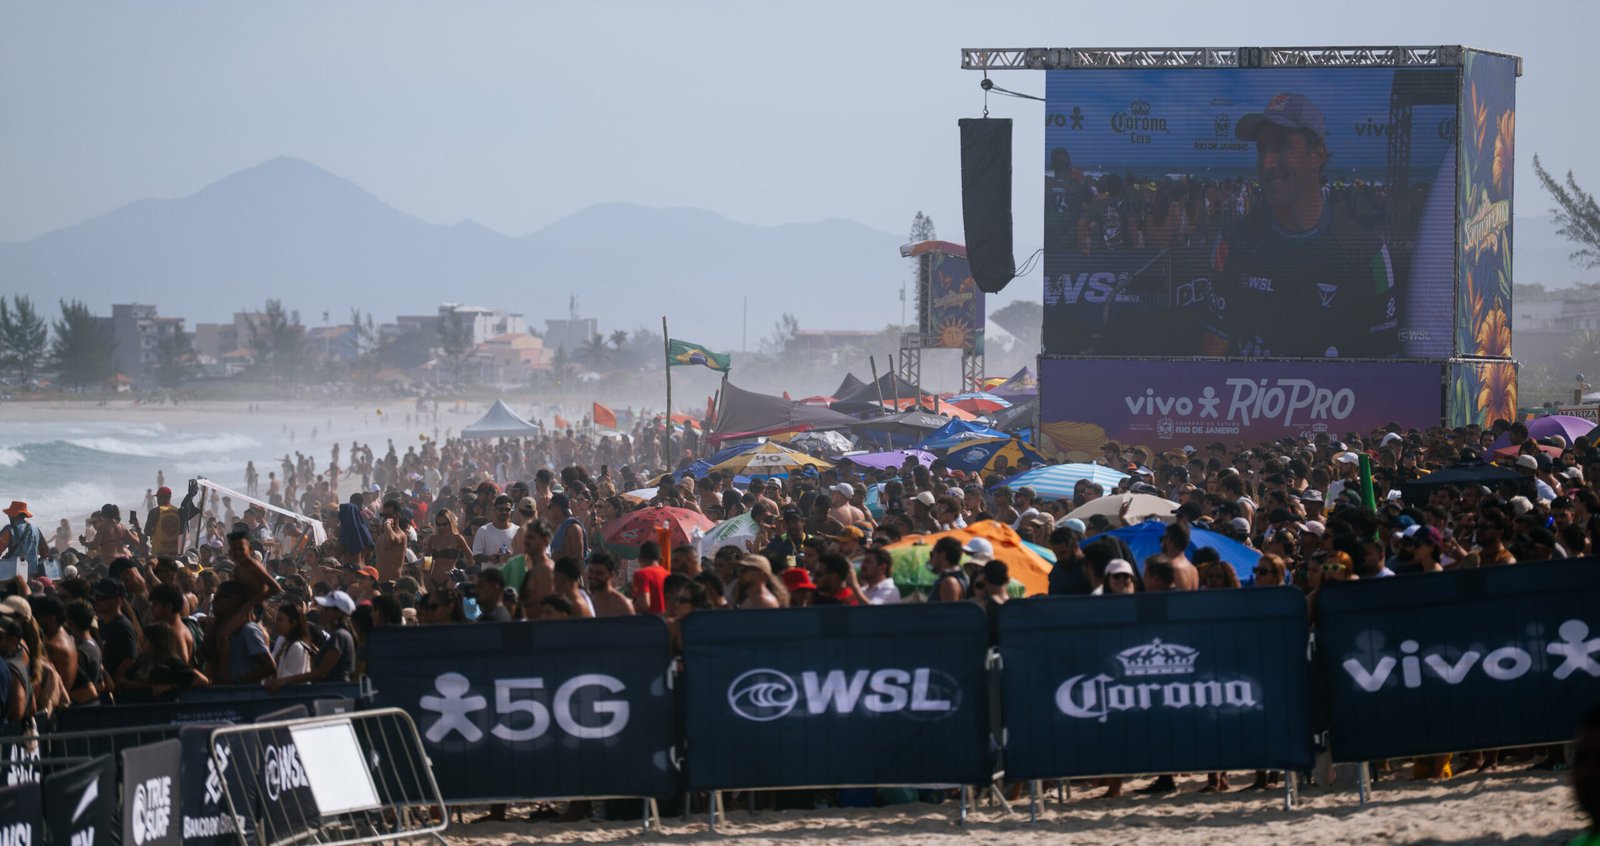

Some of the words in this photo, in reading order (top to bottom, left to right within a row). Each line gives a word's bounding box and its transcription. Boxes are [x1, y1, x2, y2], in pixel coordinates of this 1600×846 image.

[1111, 111, 1168, 135] Corona
[1248, 276, 1274, 292] WSL
[1409, 329, 1431, 340] WSL
[1125, 387, 1193, 415] vivo
[1560, 410, 1597, 418] MARIZA
[1175, 426, 1190, 434] RIO
[1192, 426, 1203, 434] DE
[1205, 426, 1240, 434] JANEIRO
[1343, 639, 1532, 692] vivo
[802, 668, 951, 714] WSL
[1055, 673, 1257, 723] Corona
[490, 673, 630, 742] 5G
[146, 776, 171, 810] TRUE
[146, 807, 171, 841] SURF
